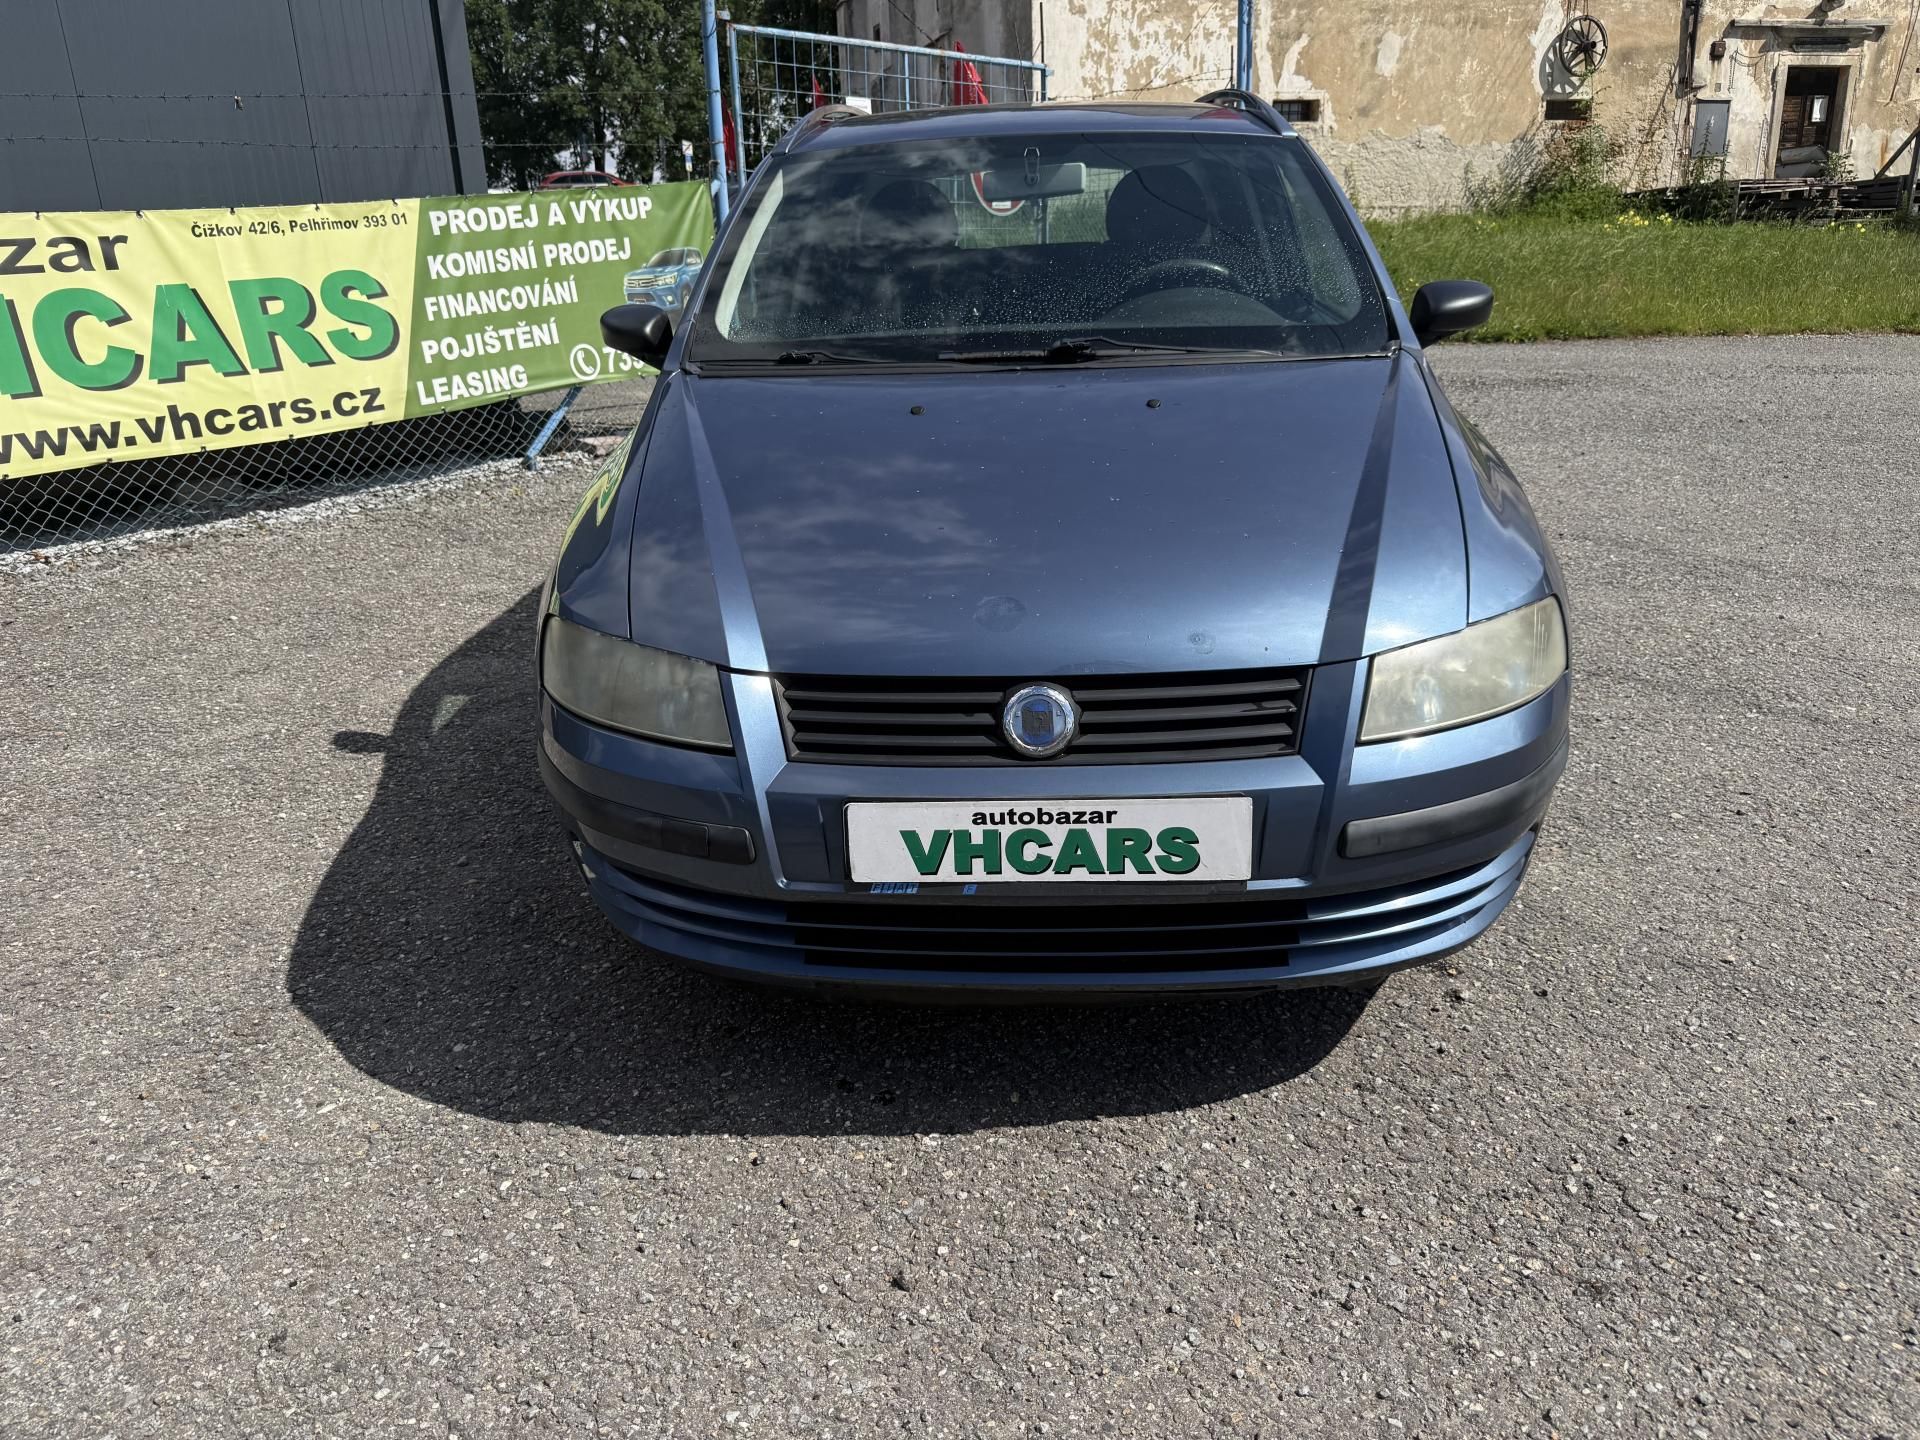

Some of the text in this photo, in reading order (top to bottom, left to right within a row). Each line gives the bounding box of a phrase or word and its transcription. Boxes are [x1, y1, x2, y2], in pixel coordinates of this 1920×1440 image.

[190, 212, 409, 239] Čížkov 42/6, Pelhřimov 393 01
[428, 194, 653, 236] PRODEJ A VÝKUP
[0, 235, 129, 275] zar
[427, 237, 631, 280] KOMISNÍ PRODEJ
[424, 275, 579, 322] FINANCOVÁNÍ
[421, 318, 560, 364] POJIŠTĚNÍ
[416, 364, 528, 406] LEASING
[0, 388, 386, 465] ww.vhcars.cz
[971, 807, 1118, 826] autobazar
[899, 826, 1201, 876] VHCARS
